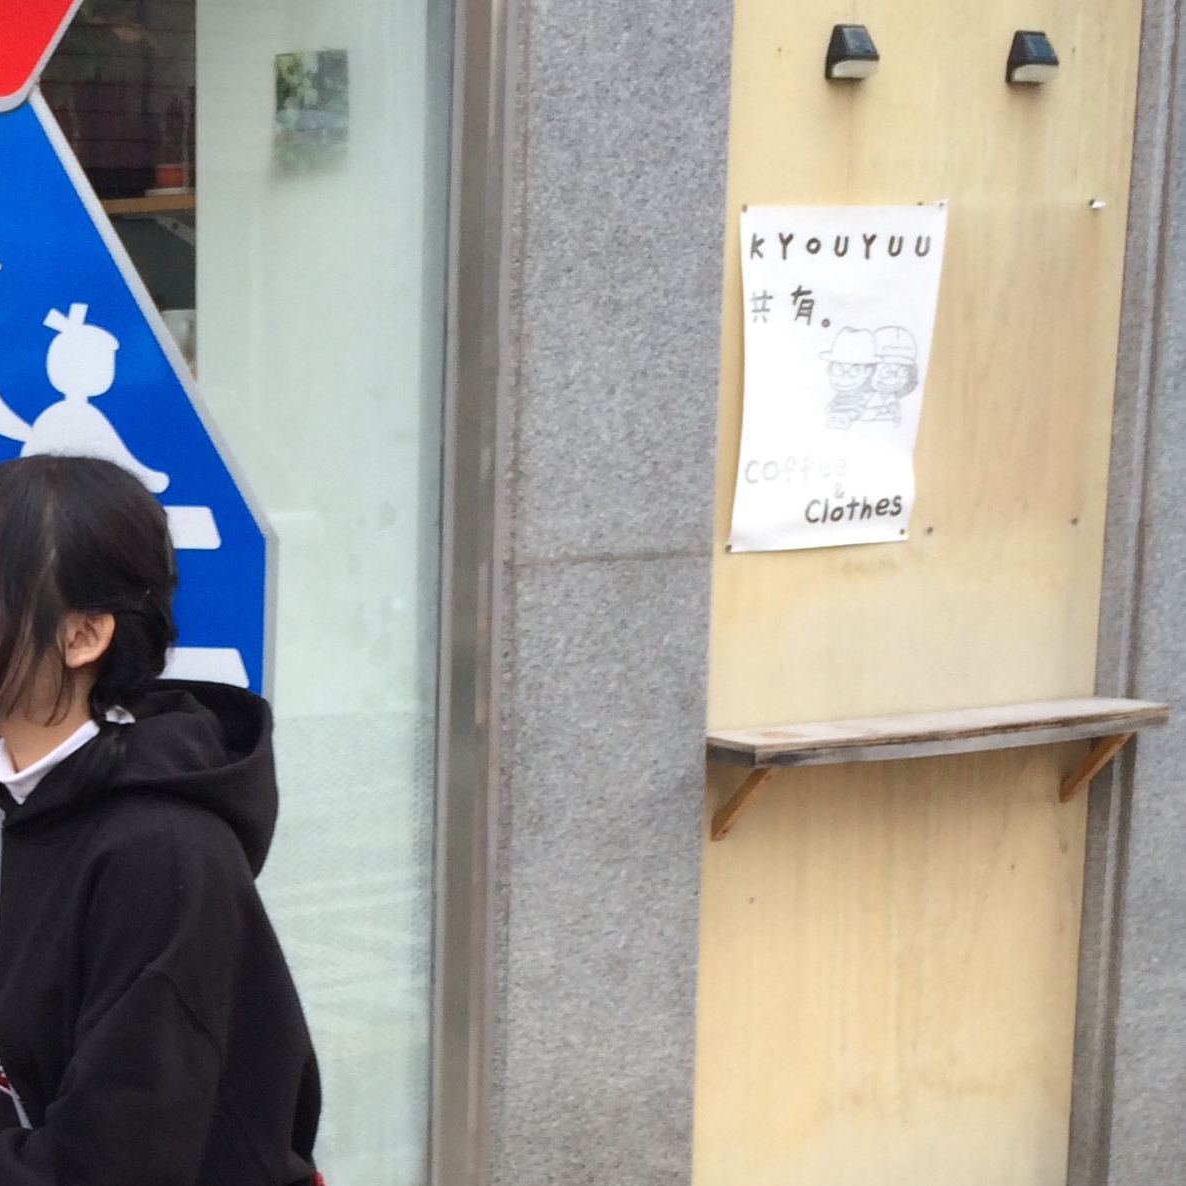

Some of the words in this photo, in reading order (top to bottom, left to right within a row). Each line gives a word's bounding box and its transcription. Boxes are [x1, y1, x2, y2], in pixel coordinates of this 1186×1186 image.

[750, 232, 932, 260] KYOUYUU
[833, 482, 845, 499] &
[805, 495, 902, 524] Clothes
